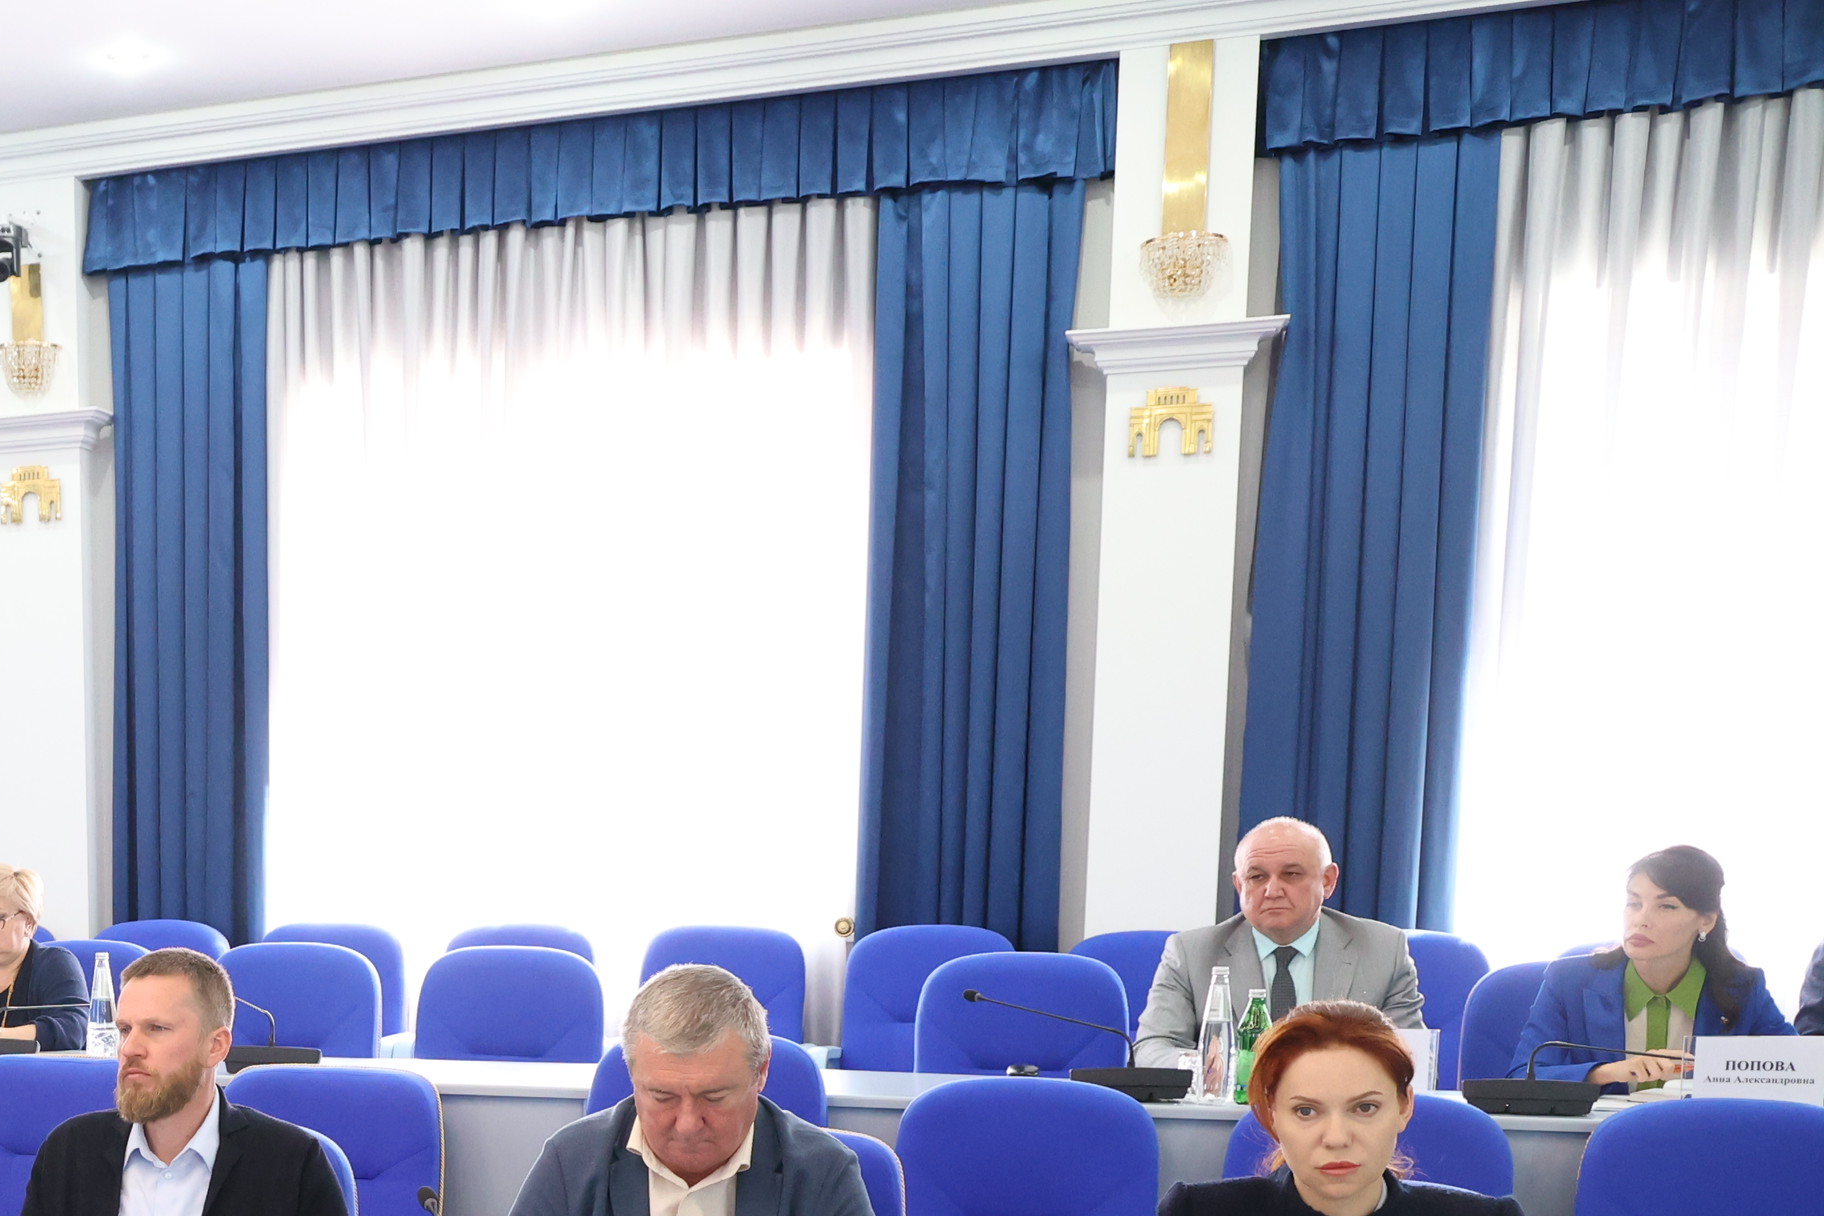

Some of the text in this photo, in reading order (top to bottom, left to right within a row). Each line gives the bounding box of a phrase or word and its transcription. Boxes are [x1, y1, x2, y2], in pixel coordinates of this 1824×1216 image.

[1725, 1060, 1796, 1072] ПОПОВА
[1704, 1075, 1816, 1086] Анна Александровна
